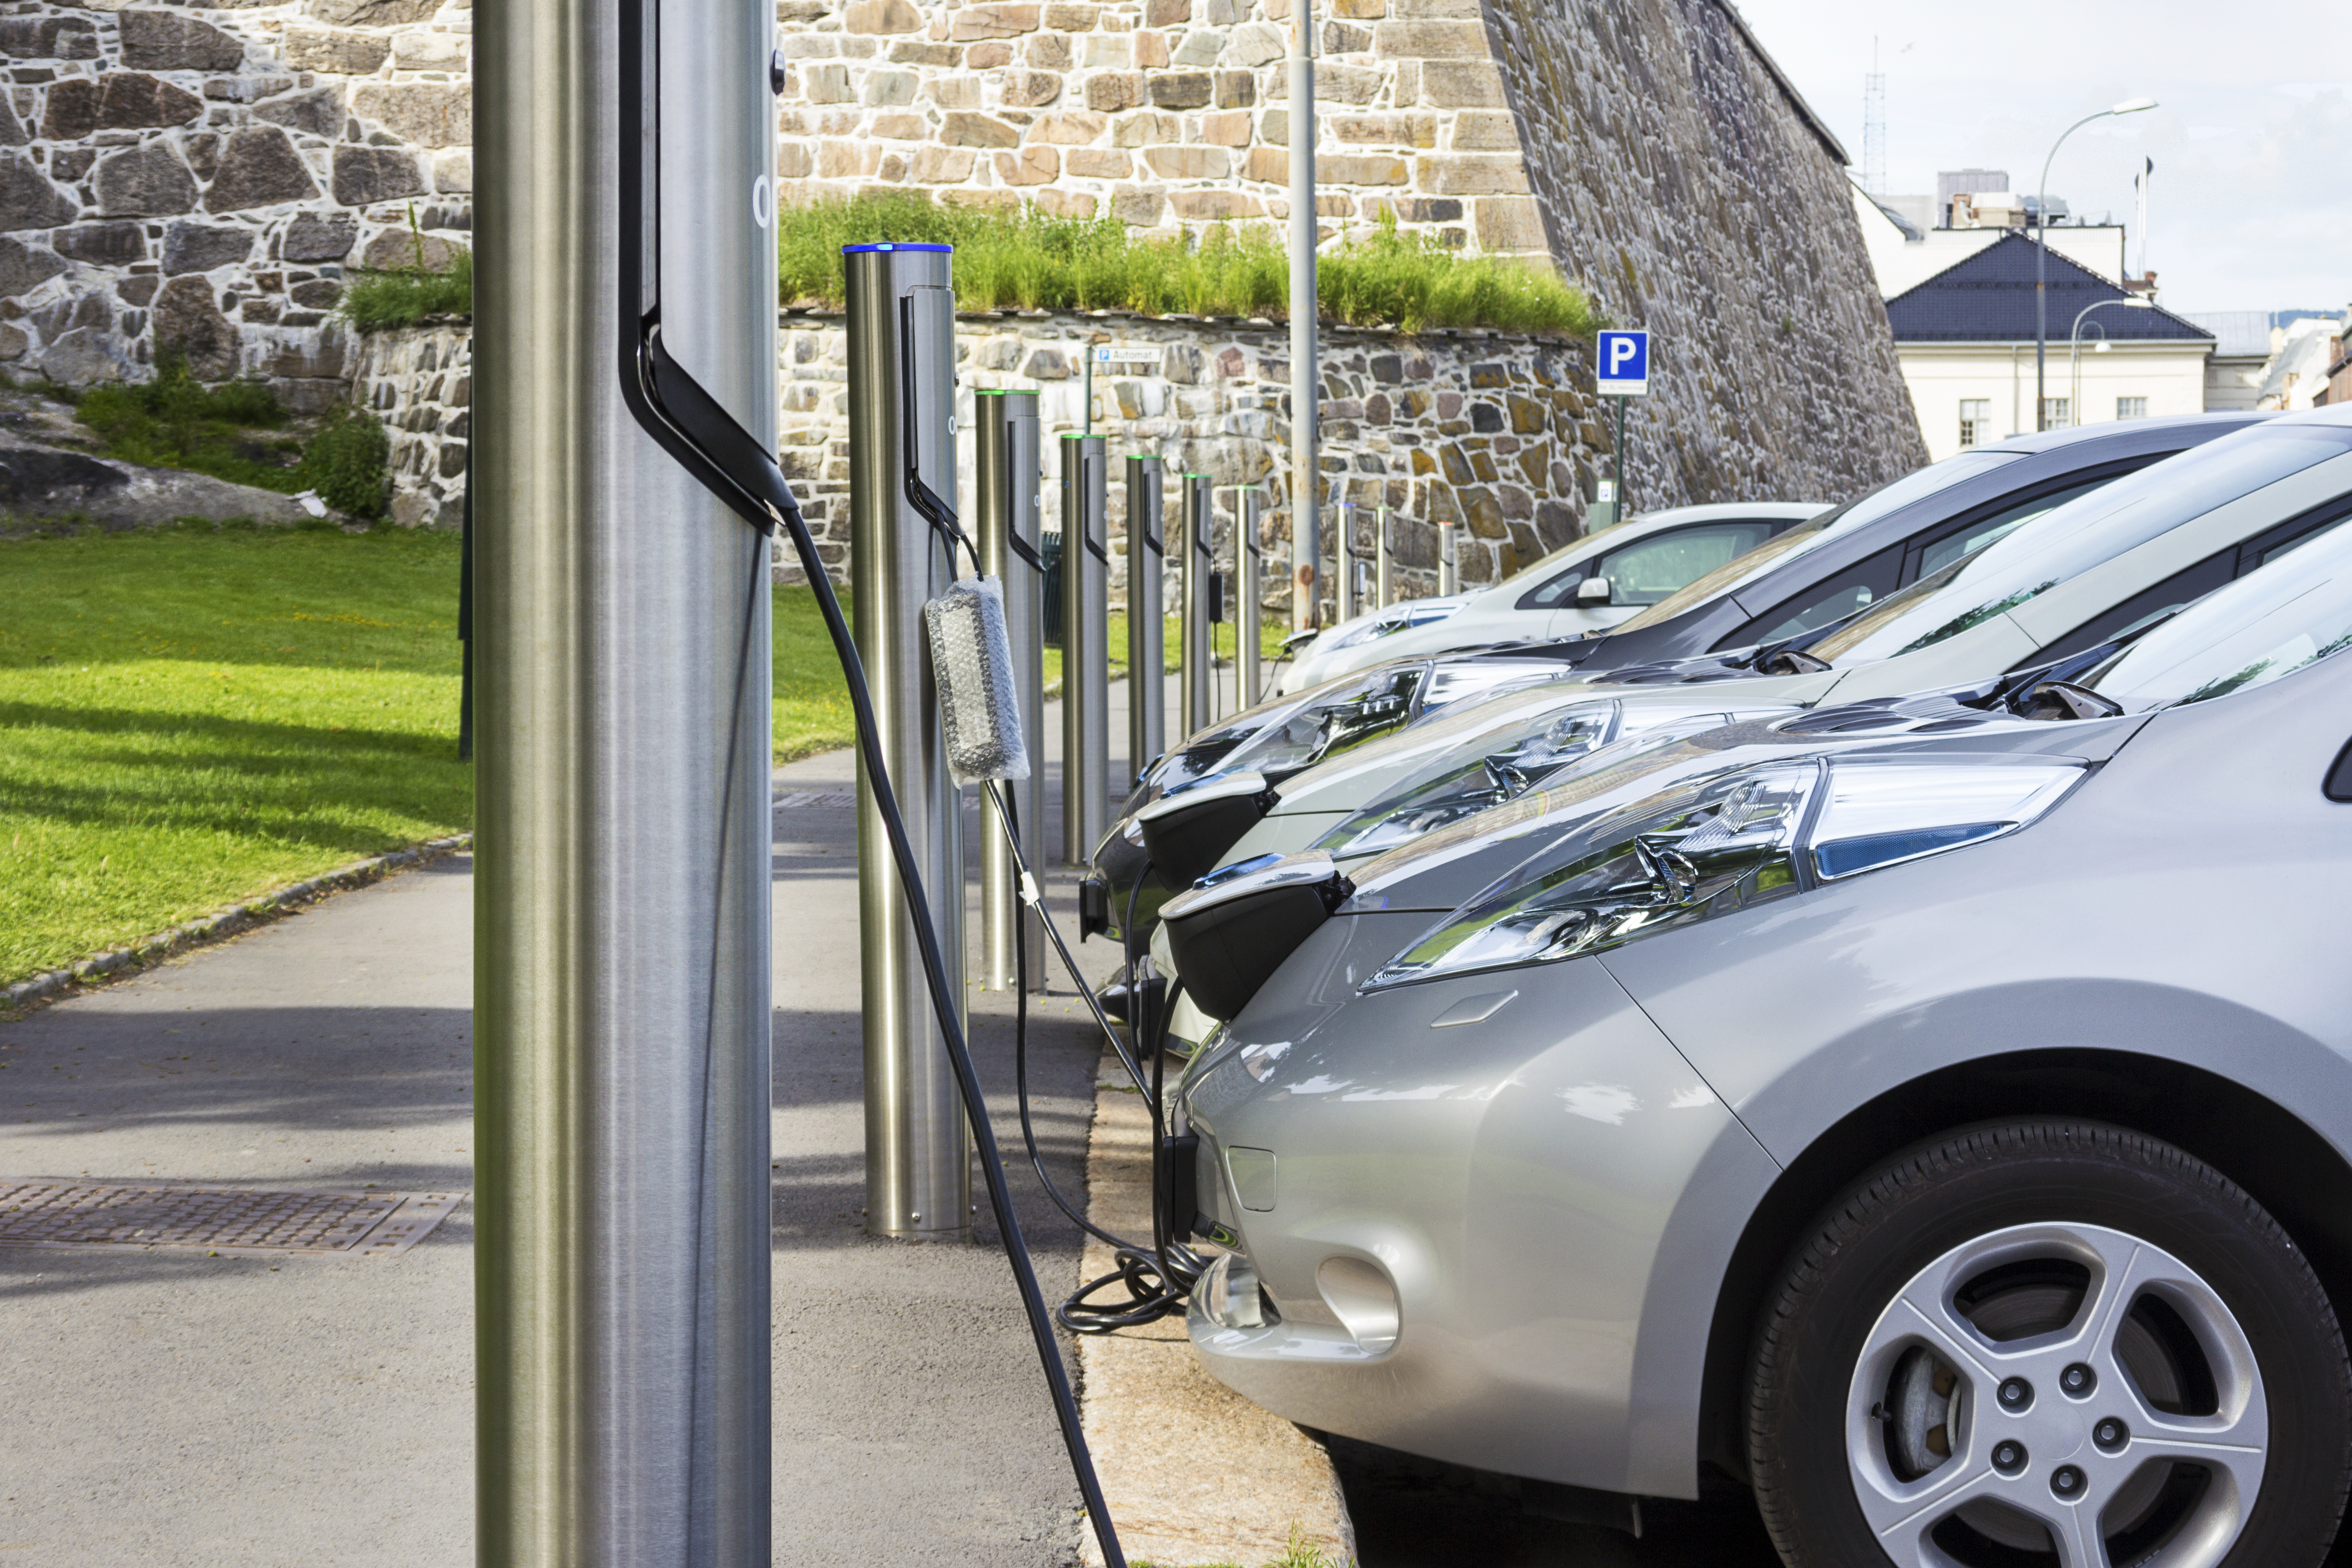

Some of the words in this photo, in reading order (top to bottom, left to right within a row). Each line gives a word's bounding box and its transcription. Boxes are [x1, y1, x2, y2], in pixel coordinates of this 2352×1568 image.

[1101, 350, 1107, 360] P
[1113, 350, 1152, 359] Automat
[1610, 337, 1636, 375] P
